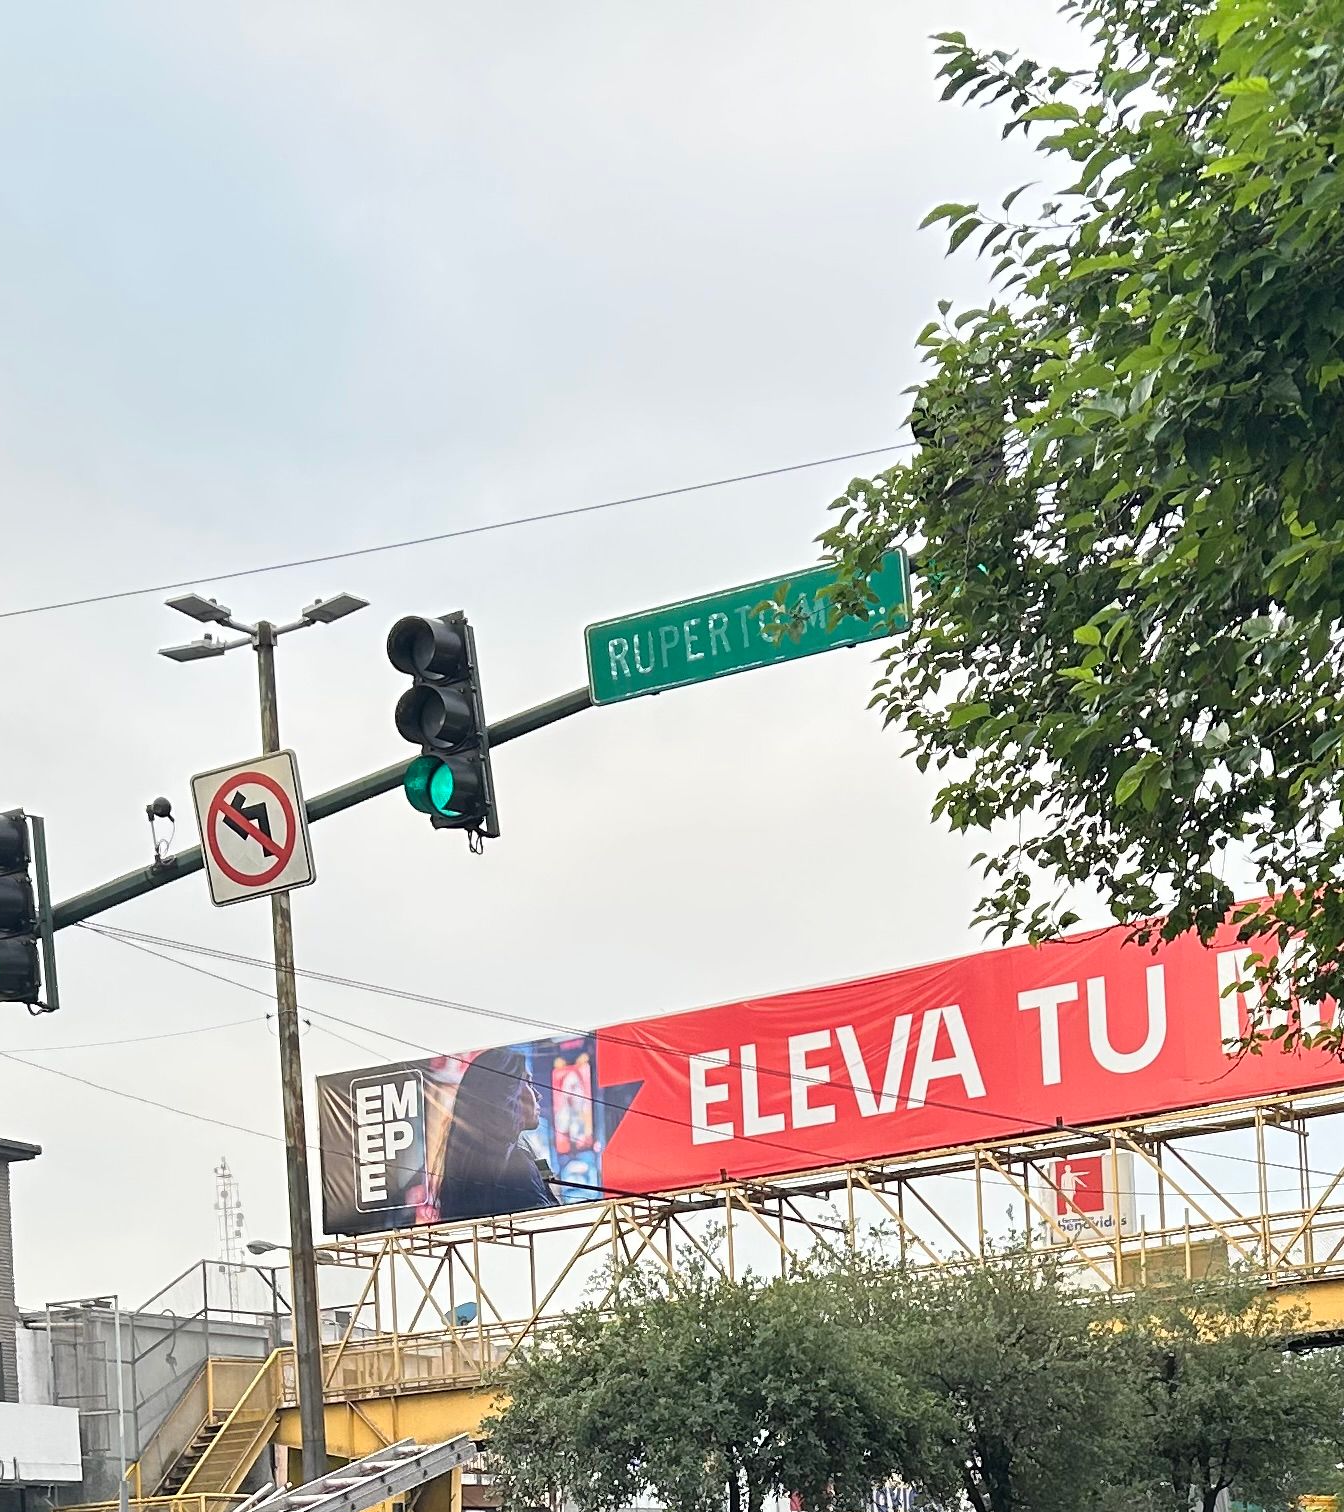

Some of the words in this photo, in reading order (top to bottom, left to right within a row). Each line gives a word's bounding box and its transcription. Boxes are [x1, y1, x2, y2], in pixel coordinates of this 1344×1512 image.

[609, 600, 786, 681] RUPERTO
[689, 1004, 987, 1145] ELEVA
[1017, 964, 1167, 1086] TU
[356, 1080, 418, 1125] EM
[358, 1121, 414, 1164] EP
[360, 1163, 388, 1203] E
